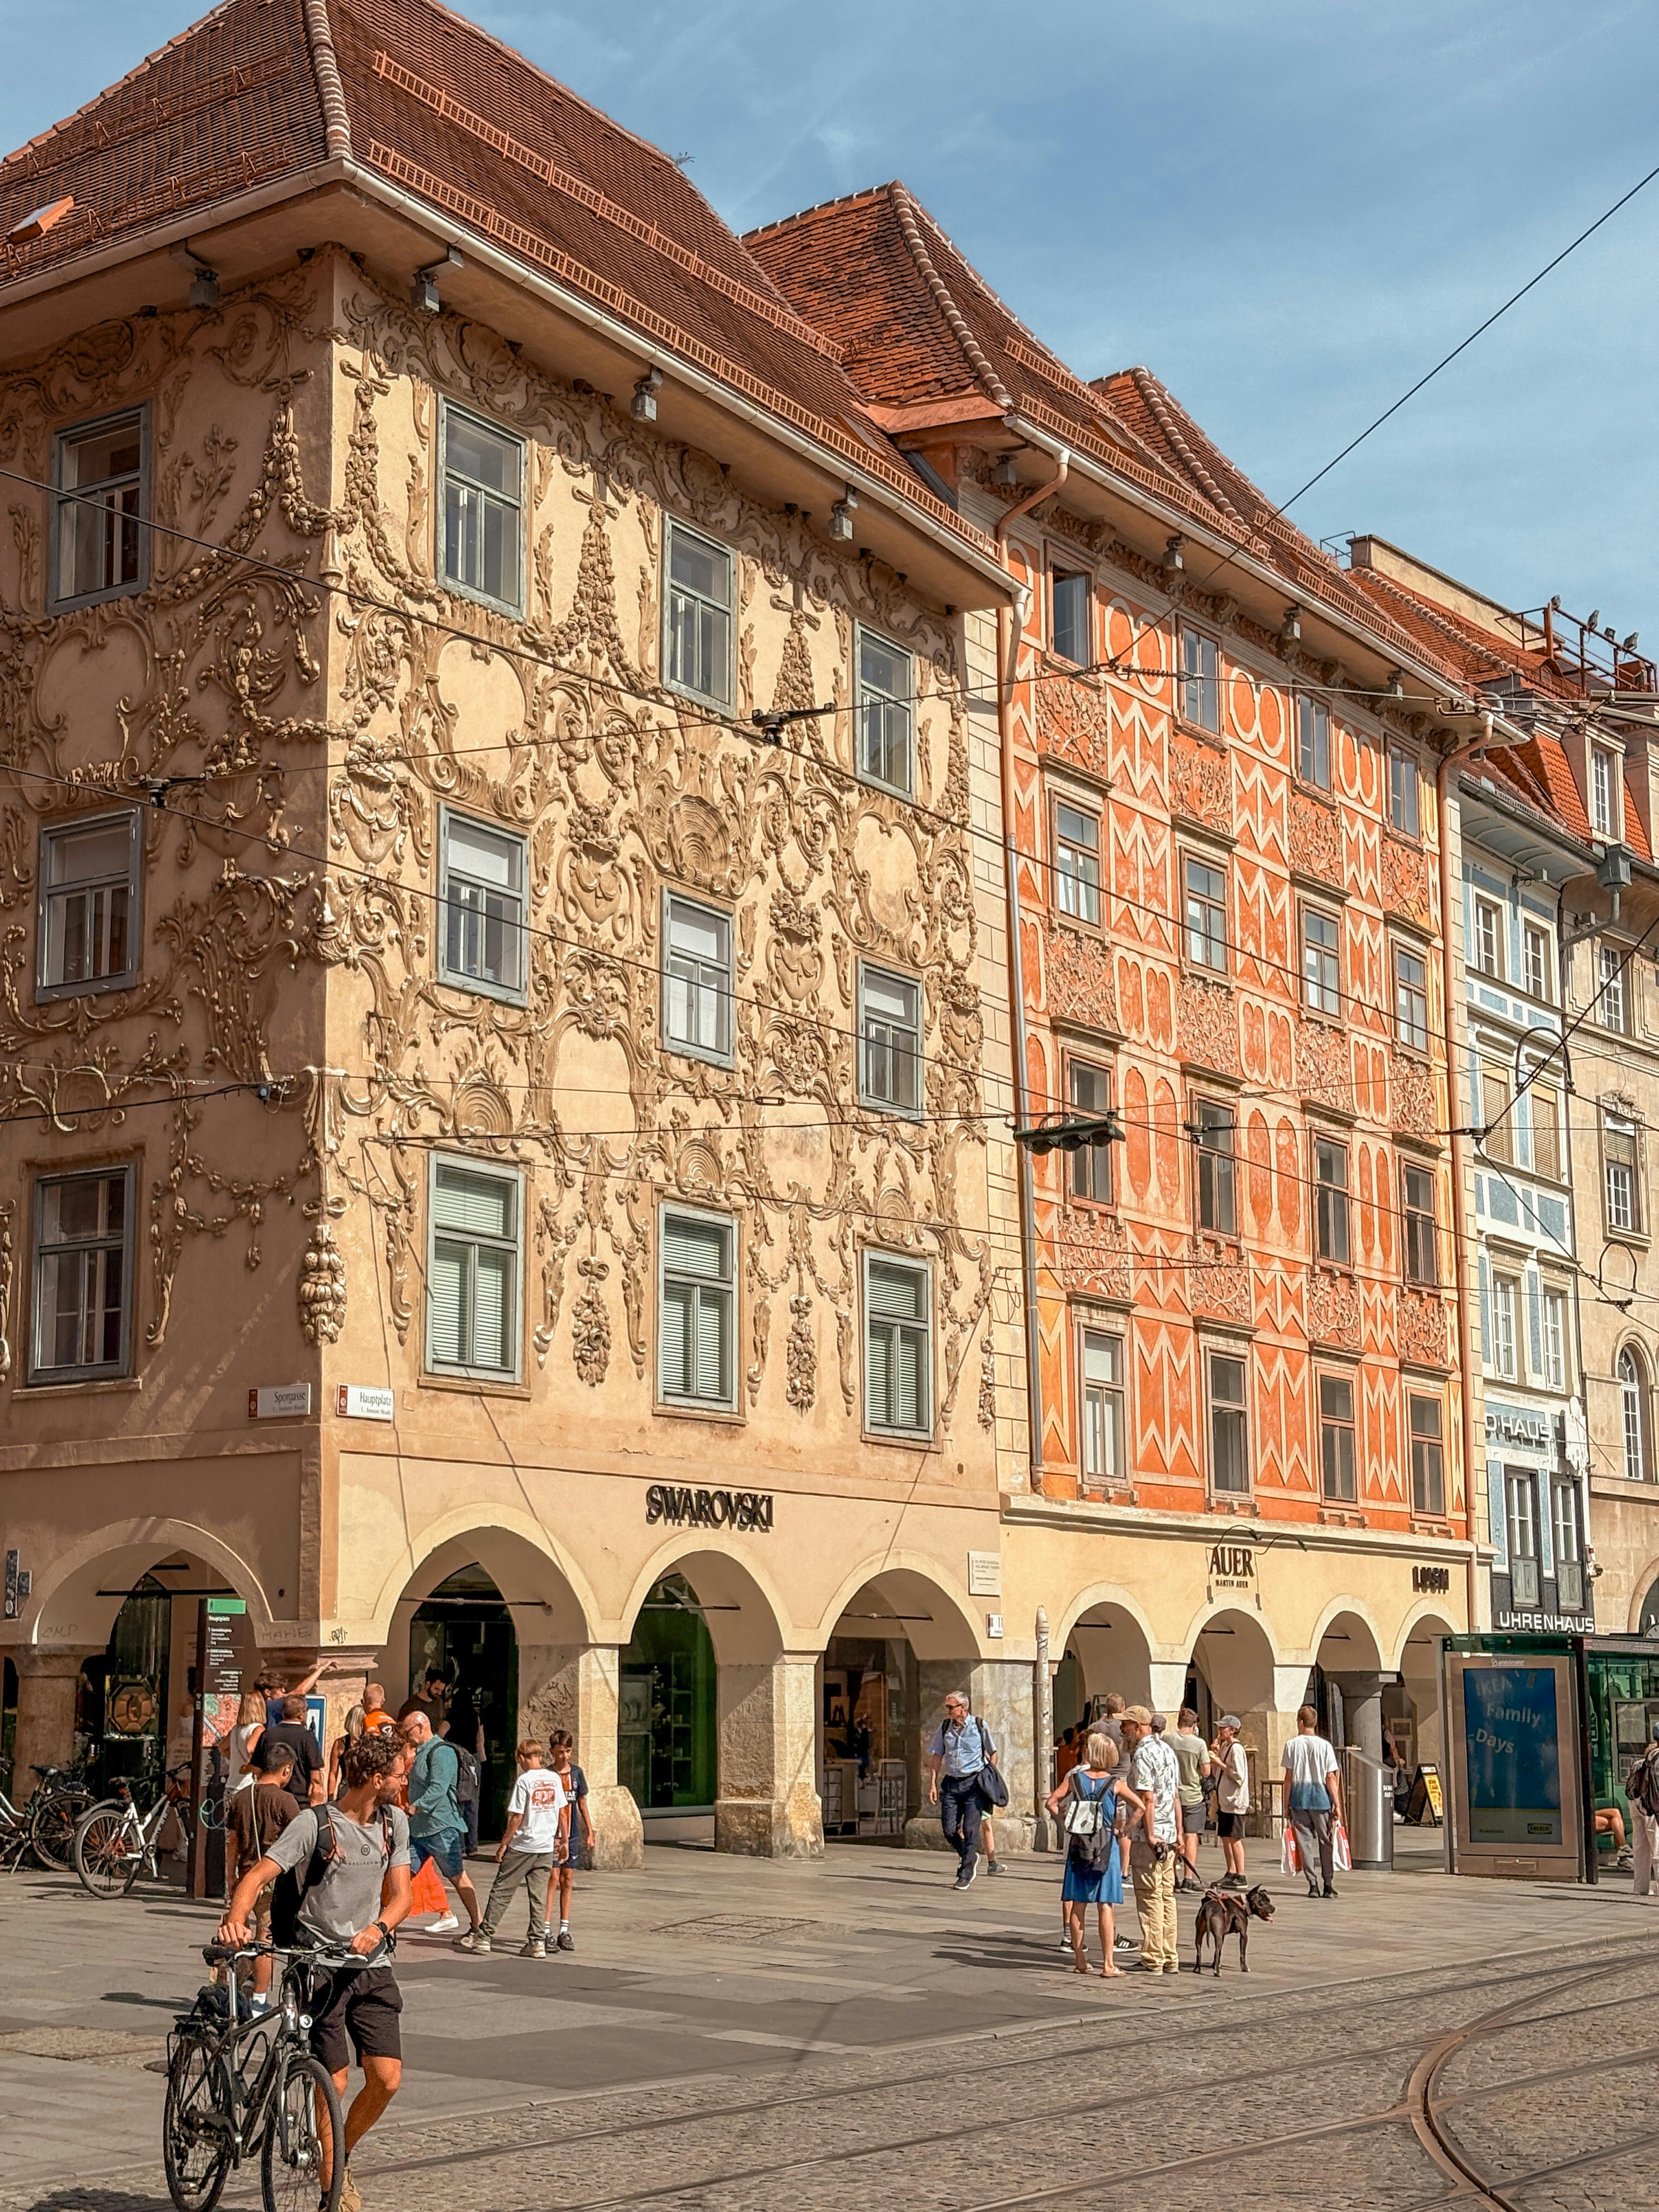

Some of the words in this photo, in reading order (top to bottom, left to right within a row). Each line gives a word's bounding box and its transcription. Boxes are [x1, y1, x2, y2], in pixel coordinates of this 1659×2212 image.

[274, 1391, 306, 1404] Sporgasse
[360, 1392, 392, 1407] Hauptplatz
[646, 1485, 775, 1530] SWAROVSKI
[1209, 1546, 1255, 1578] AUER
[1215, 1579, 1234, 1587] MARTIN
[1235, 1580, 1248, 1589] AUER
[1412, 1566, 1449, 1592] LUSH
[1499, 1611, 1595, 1633] UHRENHAUS
[1486, 1702, 1541, 1729] Family
[1475, 1728, 1514, 1753] Days
